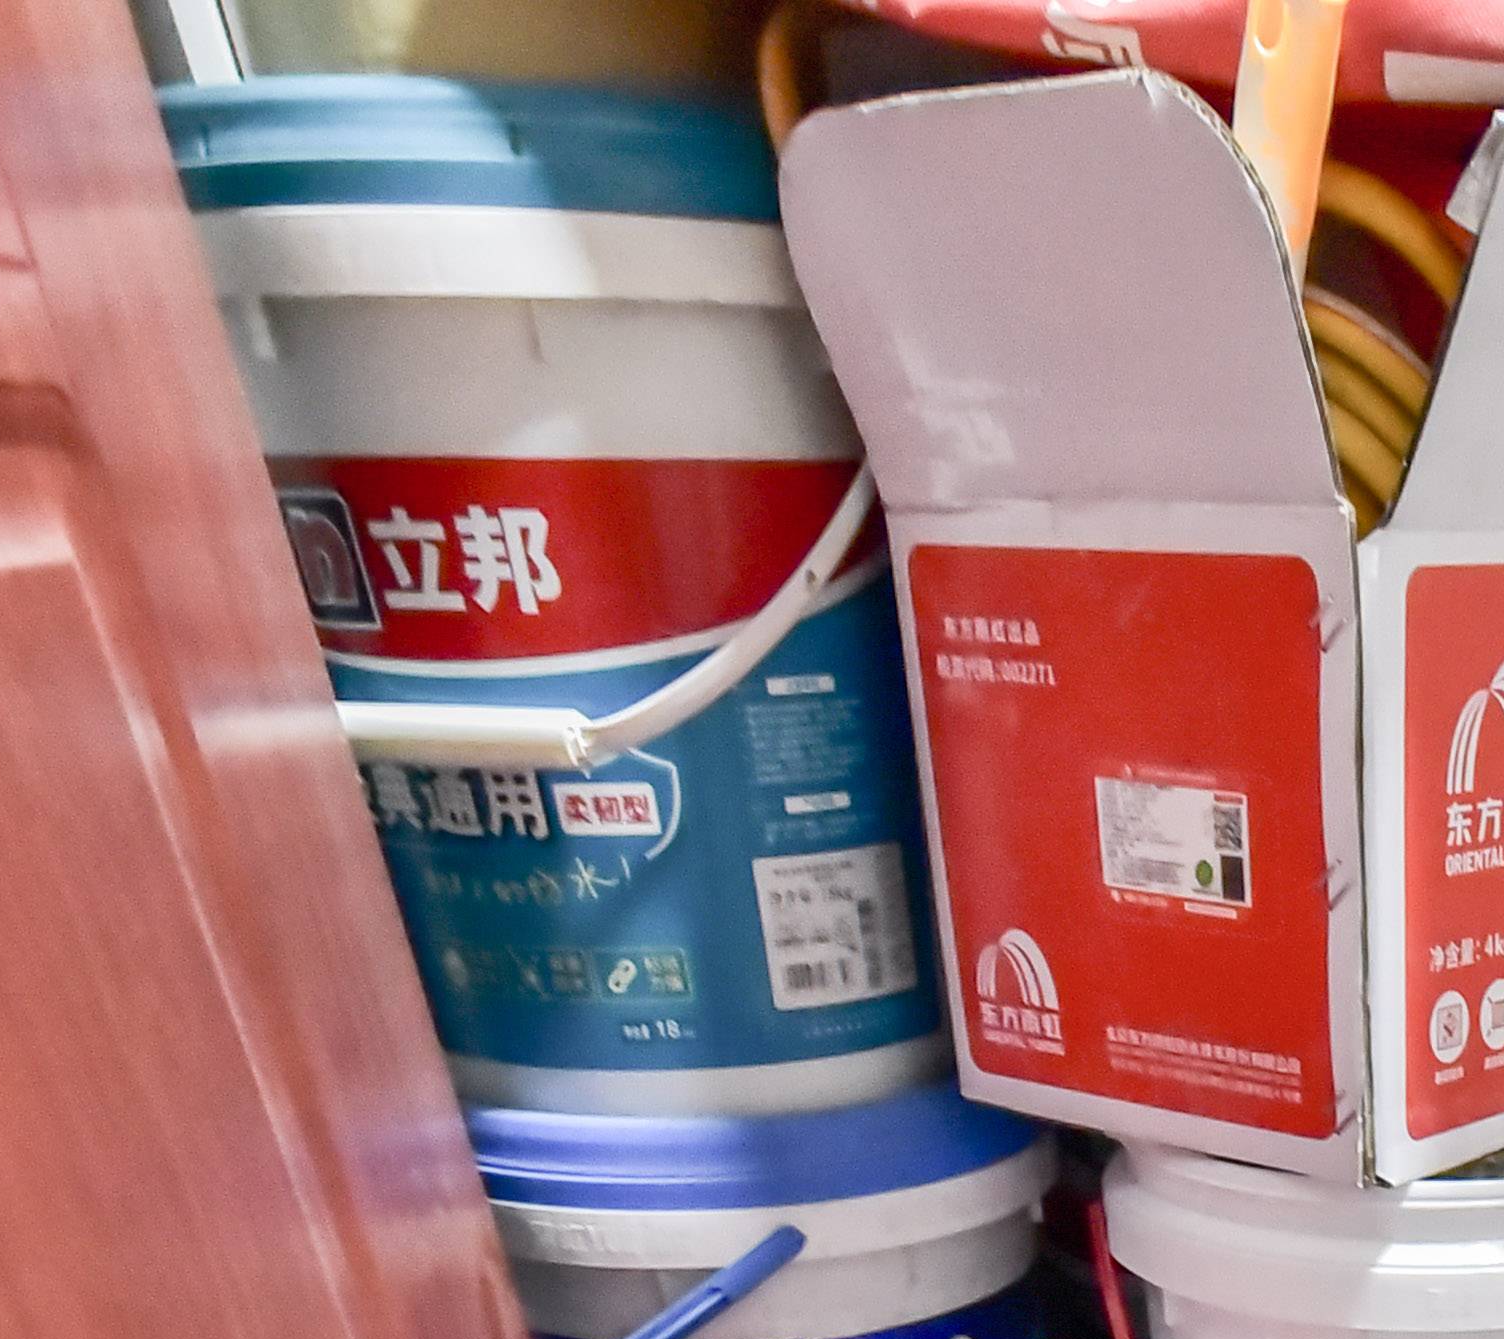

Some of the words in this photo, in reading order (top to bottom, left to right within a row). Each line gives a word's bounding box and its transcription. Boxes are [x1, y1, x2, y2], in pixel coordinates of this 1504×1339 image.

[368, 504, 563, 616] 立邦
[565, 794, 652, 825] 柔韧型
